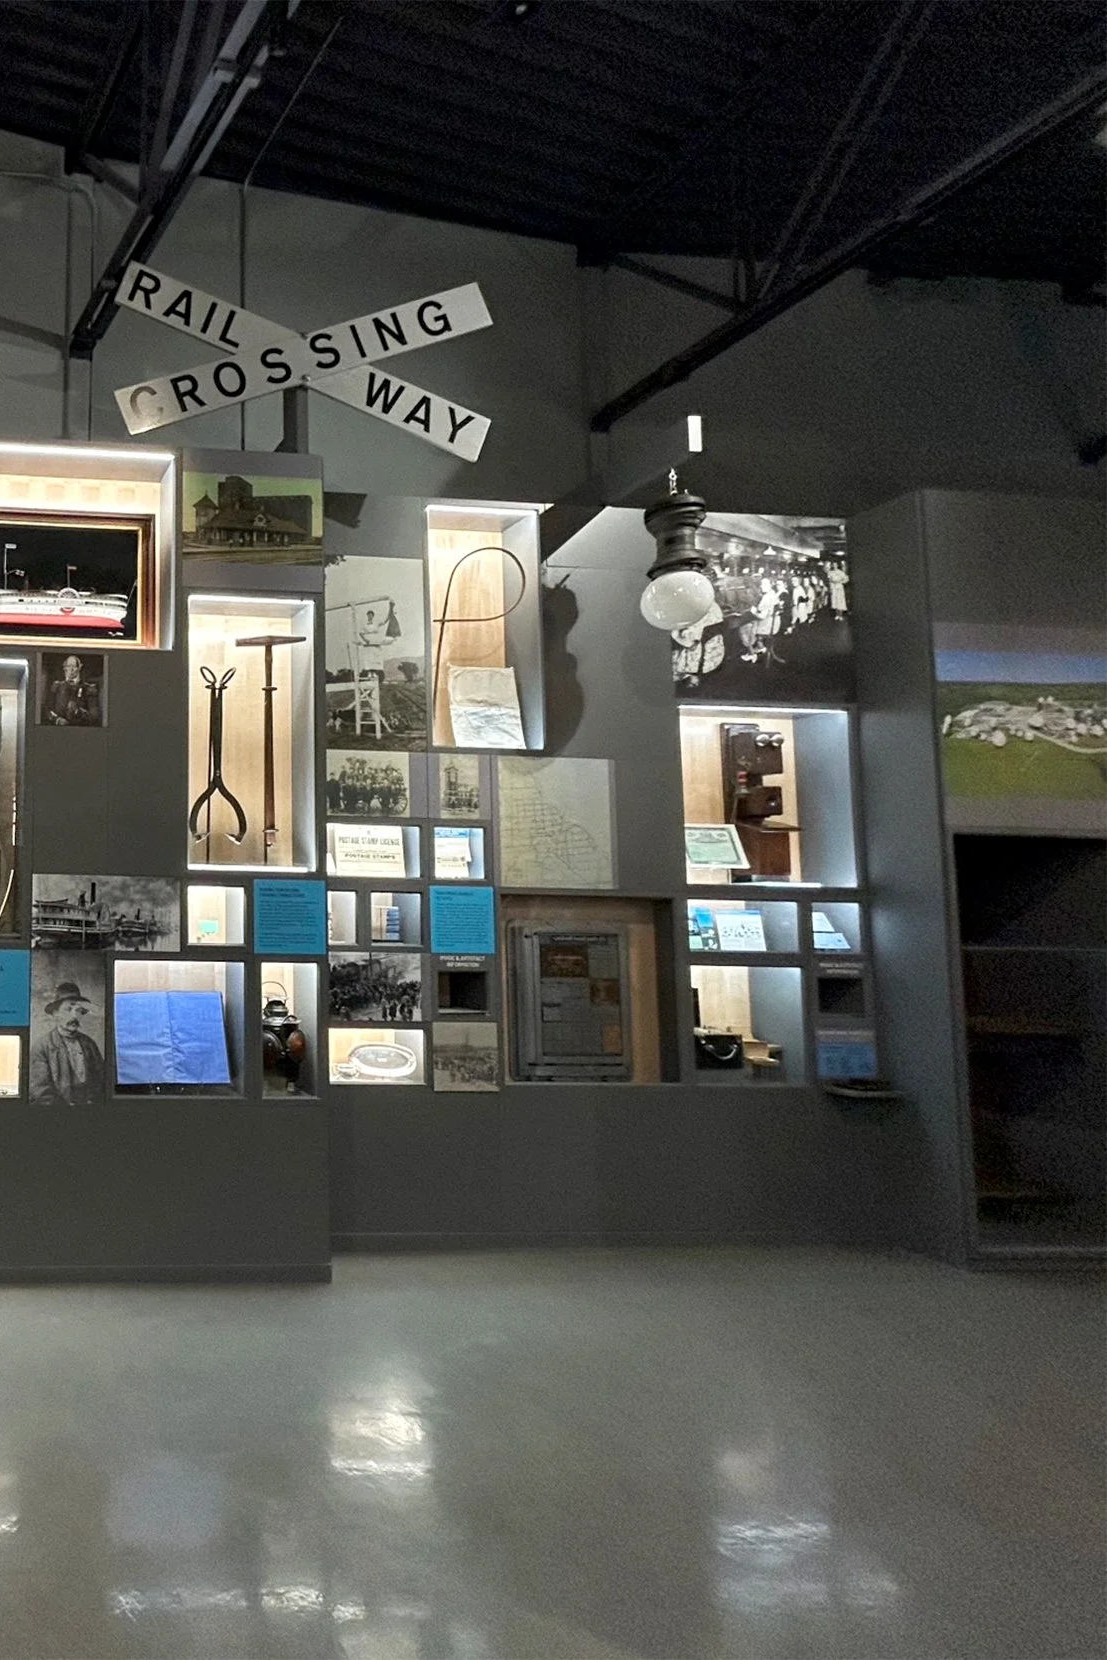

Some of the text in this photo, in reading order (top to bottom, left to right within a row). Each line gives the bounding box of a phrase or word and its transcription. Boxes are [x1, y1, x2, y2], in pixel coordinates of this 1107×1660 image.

[127, 269, 476, 444] RAIL WAY
[129, 300, 453, 421] CROSSING
